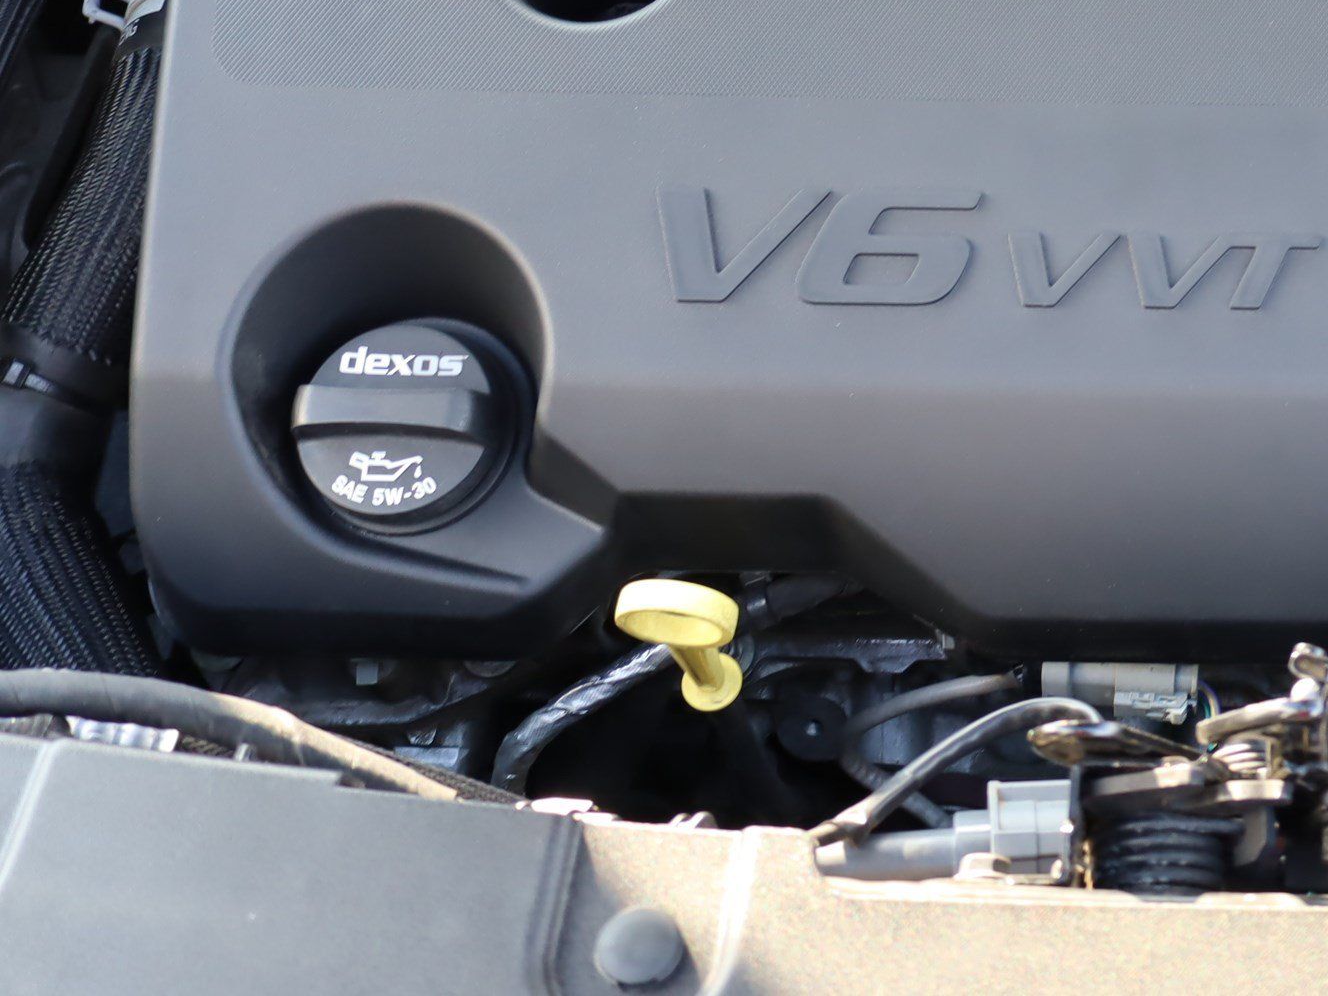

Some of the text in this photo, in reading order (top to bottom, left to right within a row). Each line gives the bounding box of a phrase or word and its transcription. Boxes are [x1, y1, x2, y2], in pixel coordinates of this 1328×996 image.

[656, 187, 1324, 311] V6 VVT
[339, 346, 469, 377] dexos
[331, 474, 437, 506] SAE 5W-30
